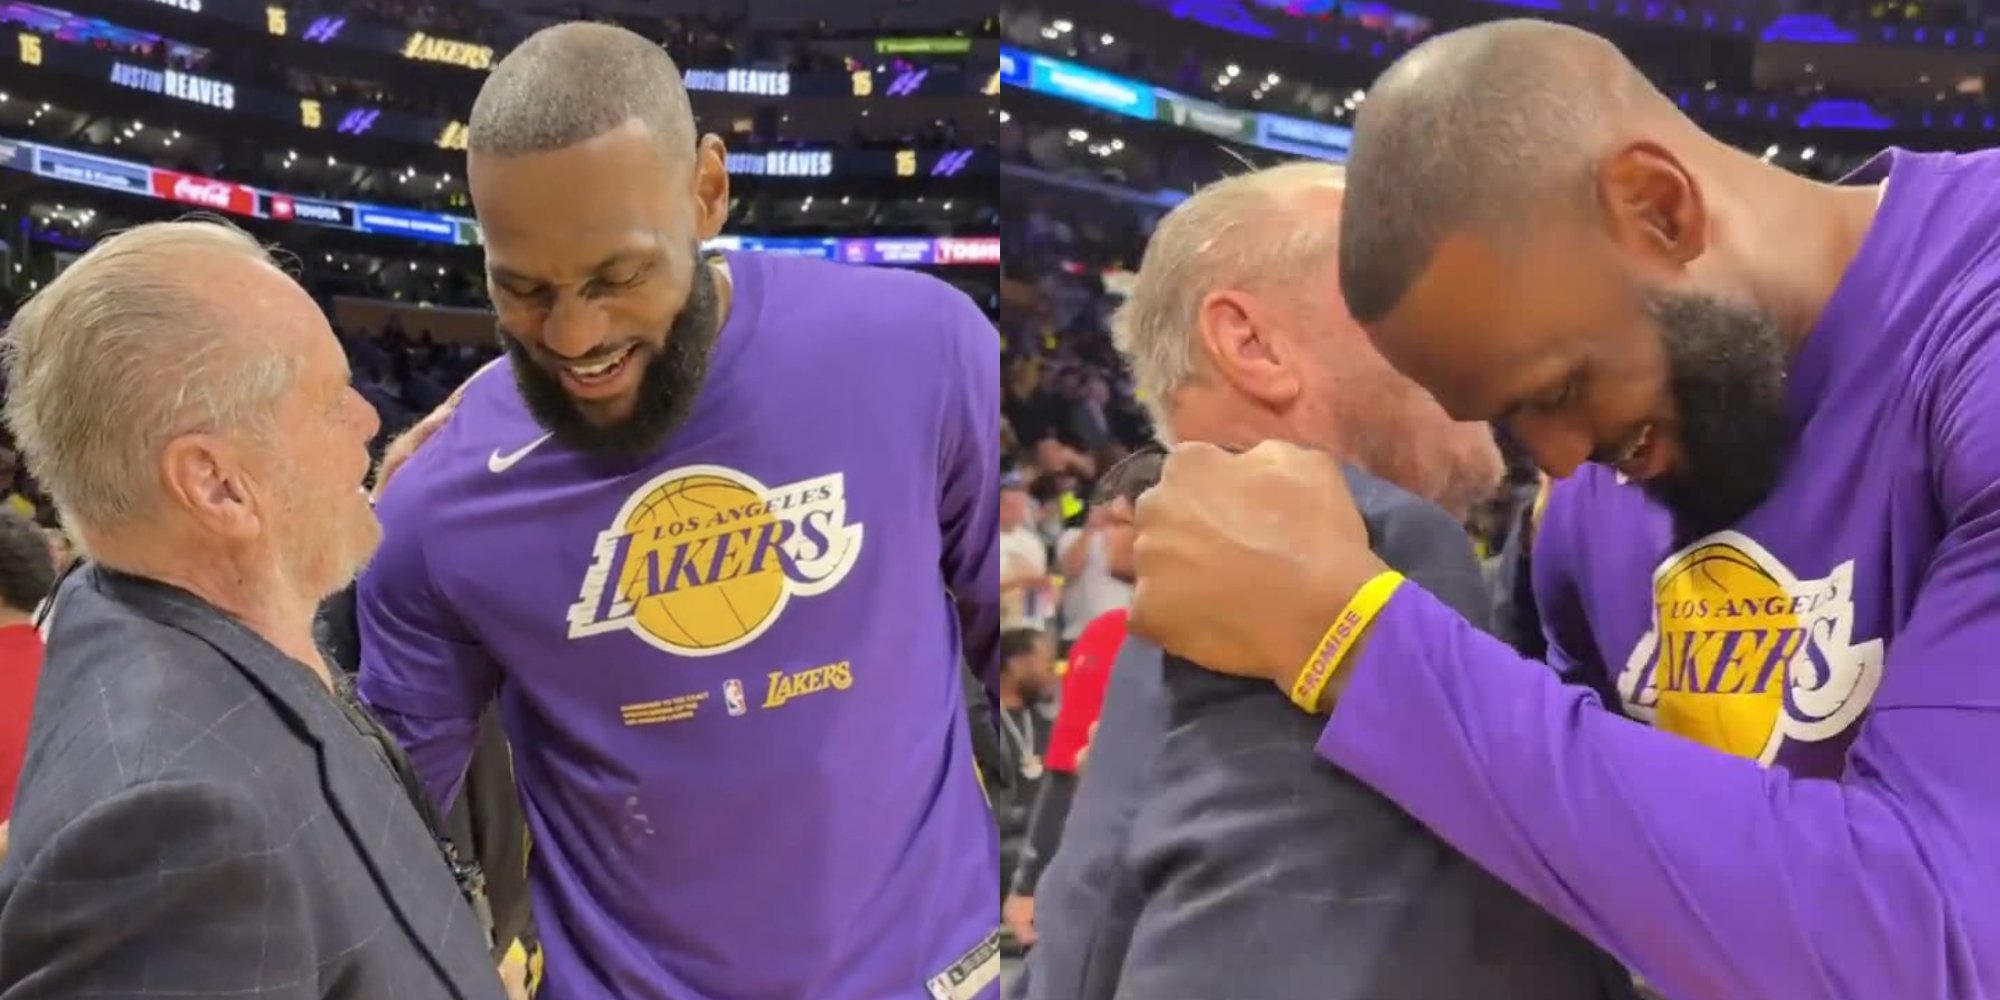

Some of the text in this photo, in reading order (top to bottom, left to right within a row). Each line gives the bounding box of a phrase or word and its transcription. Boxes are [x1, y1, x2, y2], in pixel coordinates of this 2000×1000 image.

[266, 8, 287, 36] 15
[18, 34, 42, 66] 15
[402, 33, 492, 70] LAKERS
[110, 62, 235, 110] AUSTIN REAVES
[727, 68, 791, 96] REAVES
[851, 71, 872, 96] 15
[300, 100, 322, 129] 15
[766, 151, 832, 176] REAVES
[895, 151, 916, 175] 15
[295, 203, 341, 223] TOYOTA
[652, 481, 833, 541] LOS ANGELES
[581, 508, 852, 627] LAKERS
[1670, 598, 1708, 620] LOS
[1297, 609, 1361, 698] PROMISE
[762, 661, 853, 709] LAKERS
